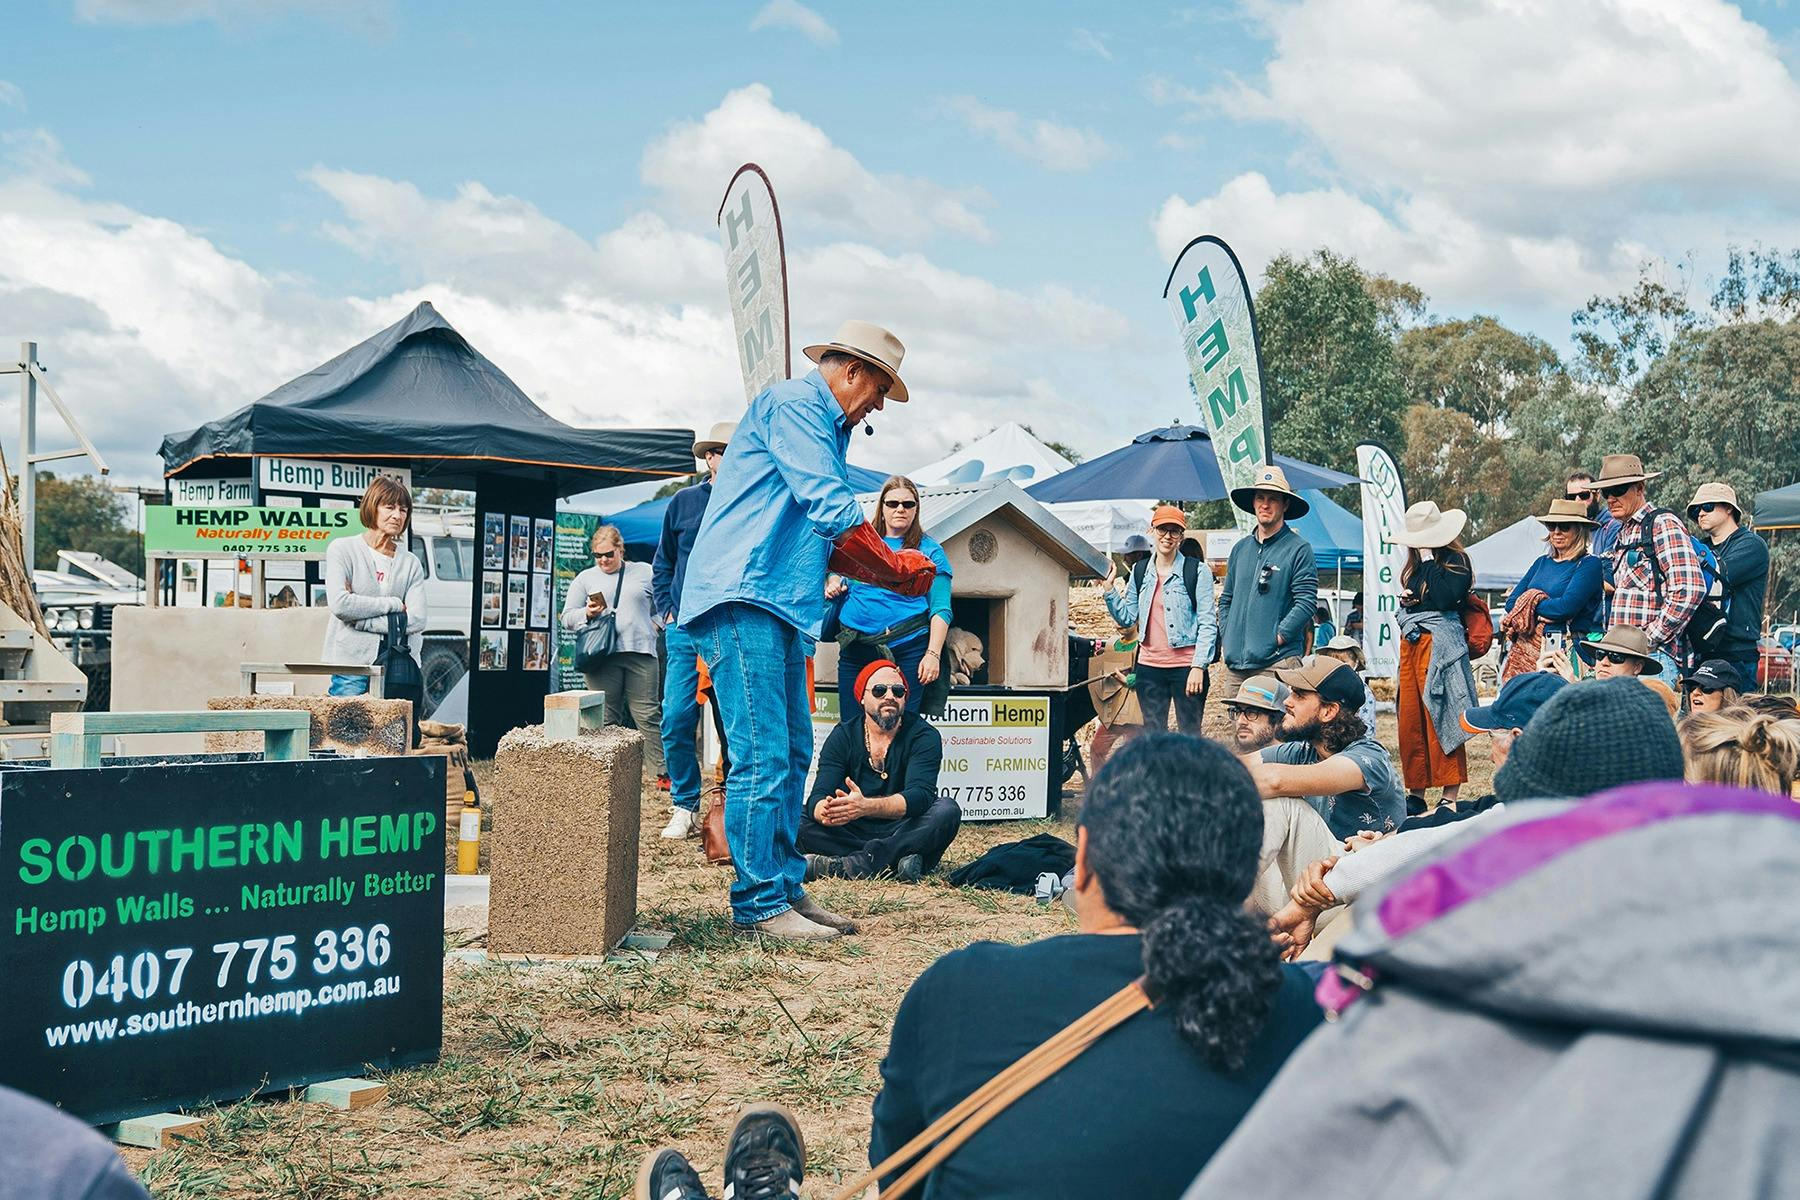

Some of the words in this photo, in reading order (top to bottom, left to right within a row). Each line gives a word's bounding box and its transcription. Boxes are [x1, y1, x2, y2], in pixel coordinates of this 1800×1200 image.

[269, 458, 325, 491] Hemp
[331, 463, 404, 490] Build
[179, 480, 214, 505] Hemp
[218, 479, 253, 500] Farm
[176, 509, 250, 526] HEMP
[259, 510, 349, 528] WALLS
[196, 527, 273, 541] Naturally
[277, 528, 331, 540] Better
[222, 544, 253, 553] 0407
[257, 544, 280, 553] 775
[284, 544, 307, 553] 336
[994, 703, 1045, 727] Hemp
[950, 735, 996, 746] Sustainable
[997, 735, 1032, 746] Solutions
[986, 757, 1047, 772] FARMING
[965, 786, 994, 802] 775
[998, 785, 1026, 802] 336
[961, 807, 1025, 818] hemp.com.au
[18, 819, 303, 885] SOUTHERN
[319, 811, 437, 859] HEMP
[15, 905, 106, 936] Hemp
[116, 892, 194, 925] Walls
[241, 877, 356, 911] Naturally
[364, 870, 436, 898] Better
[62, 946, 194, 1009] 0407
[212, 933, 297, 989] 775
[311, 923, 391, 974] 336
[45, 973, 401, 1048] www.southernhemp.com.au
